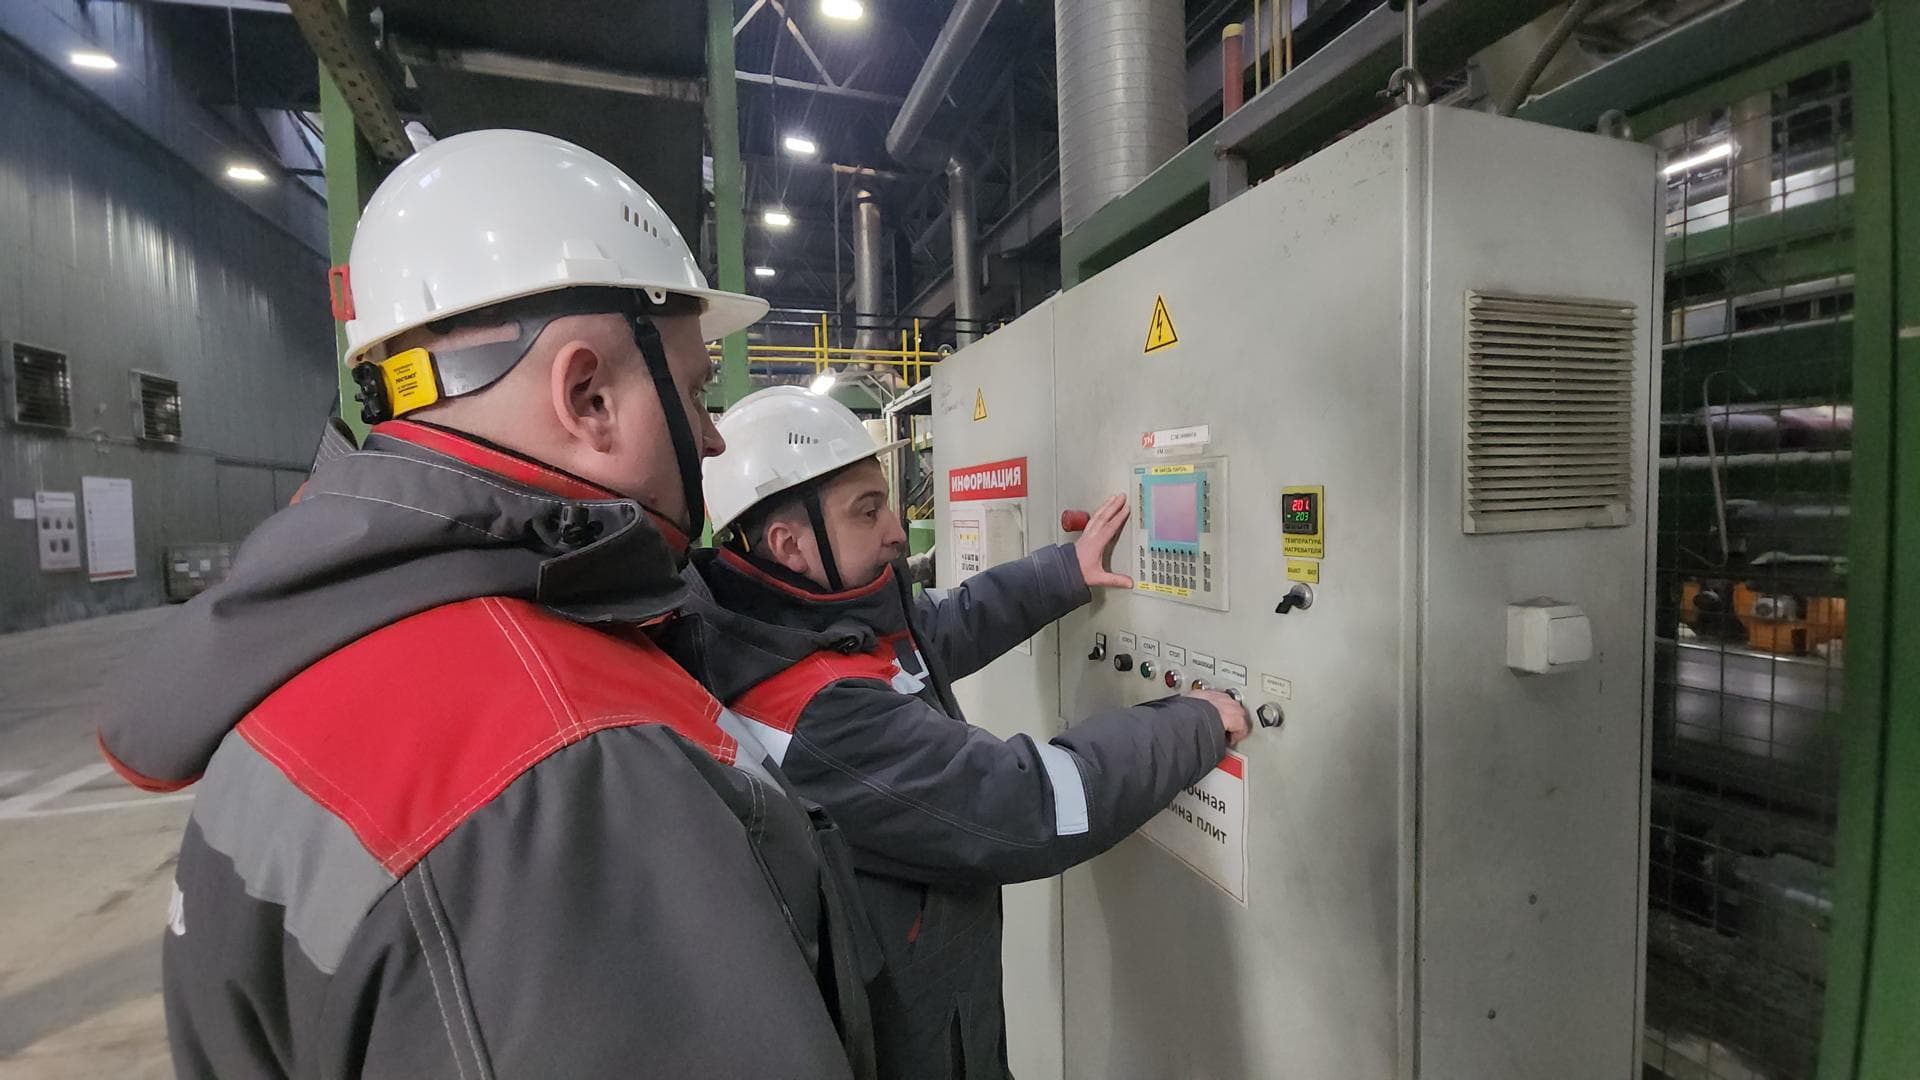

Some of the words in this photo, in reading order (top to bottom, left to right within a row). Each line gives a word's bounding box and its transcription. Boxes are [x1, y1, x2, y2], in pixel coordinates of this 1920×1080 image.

[952, 466, 1022, 493] ИНФОРМАЦИЯ
[1295, 511, 1309, 521] 203
[1285, 537, 1322, 545] ТЕМПЕРАТУРА
[1285, 546, 1322, 554] НАГРЕВАТЕЛЯ
[1186, 785, 1226, 815] очная
[1168, 800, 1193, 824] ина
[1197, 816, 1227, 844] плит
